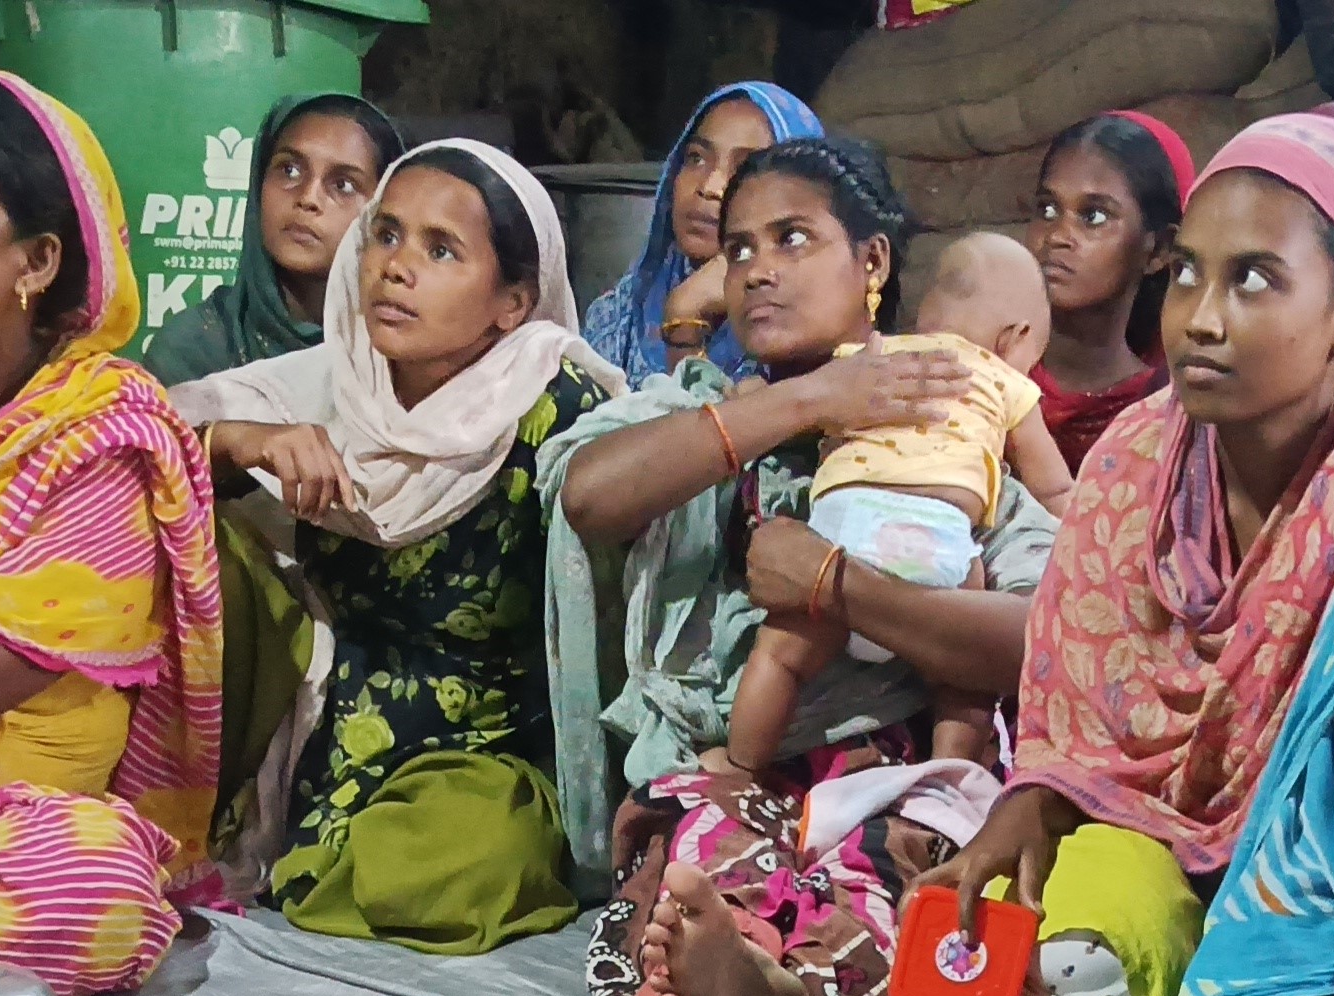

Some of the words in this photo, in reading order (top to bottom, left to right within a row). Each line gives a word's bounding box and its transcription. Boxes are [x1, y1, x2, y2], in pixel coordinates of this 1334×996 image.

[163, 255, 186, 269] +91
[189, 256, 205, 269] 22
[207, 256, 239, 270] 2857
